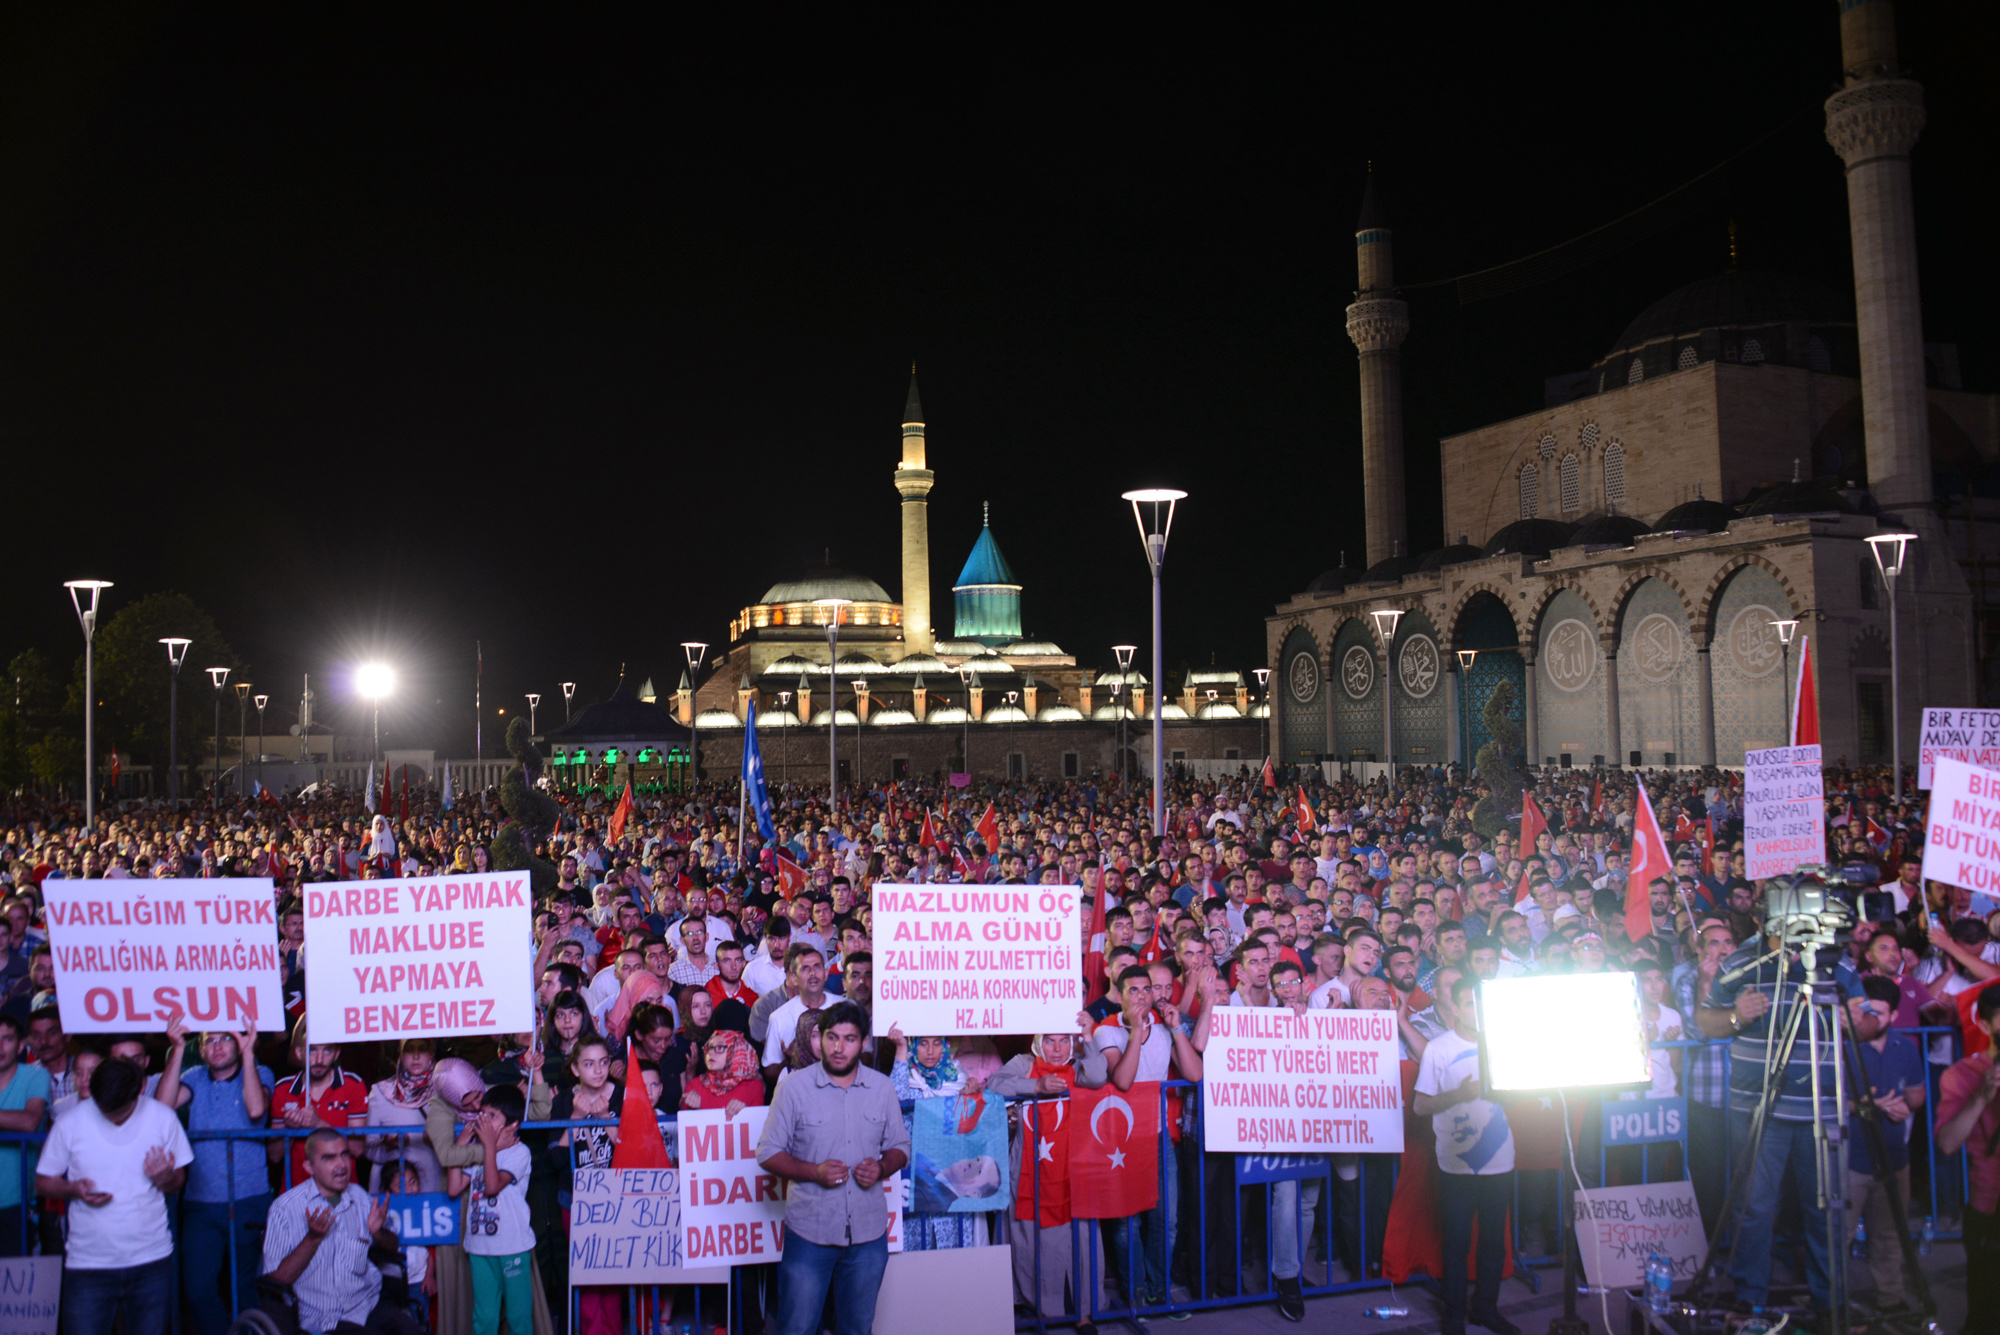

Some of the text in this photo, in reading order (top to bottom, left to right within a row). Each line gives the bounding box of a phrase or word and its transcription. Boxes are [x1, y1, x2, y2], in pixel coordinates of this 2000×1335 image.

[1929, 711, 1952, 728] BİR
[1923, 730, 1975, 746] MİYAV
[1756, 837, 1816, 856] KAHROLSUN
[48, 894, 274, 926] VARLIĞIM TÜRK
[308, 879, 525, 919] DARBE YAPMAK
[878, 888, 1075, 919] MAZLUMUN ÖÇ
[350, 921, 485, 956] MAKLUBE
[893, 917, 1062, 942] ALMA GÜNÜ
[56, 937, 276, 972] VARLIĞINA ARMAĞAN
[884, 945, 1071, 971] ZALİMİN ZULMETTİĞİ
[353, 960, 484, 994] YAPMAYA
[880, 975, 1076, 1005] GÜNDEN DAHA KORKUNÇTUR
[84, 986, 259, 1023] OLSUN
[344, 999, 497, 1035] BENZEMEZ
[956, 1003, 1003, 1029] HZ. ALİ
[1210, 1009, 1392, 1042] BU MİLLETİN YUMRUĞU
[1226, 1044, 1379, 1075] SERT YÜREĞİ MERT
[1210, 1079, 1398, 1110] VATANINA GÖZ DİKENİN
[1237, 1113, 1374, 1149] BAŞINA DERTTİR.
[1610, 1104, 1681, 1140] POLİS
[385, 1200, 454, 1239] OLİS
[574, 1197, 624, 1227] DEDİ
[687, 1222, 763, 1259] DARBE
[1600, 1222, 1689, 1244] MAKLUBE
[572, 1233, 641, 1270] MİLLET
